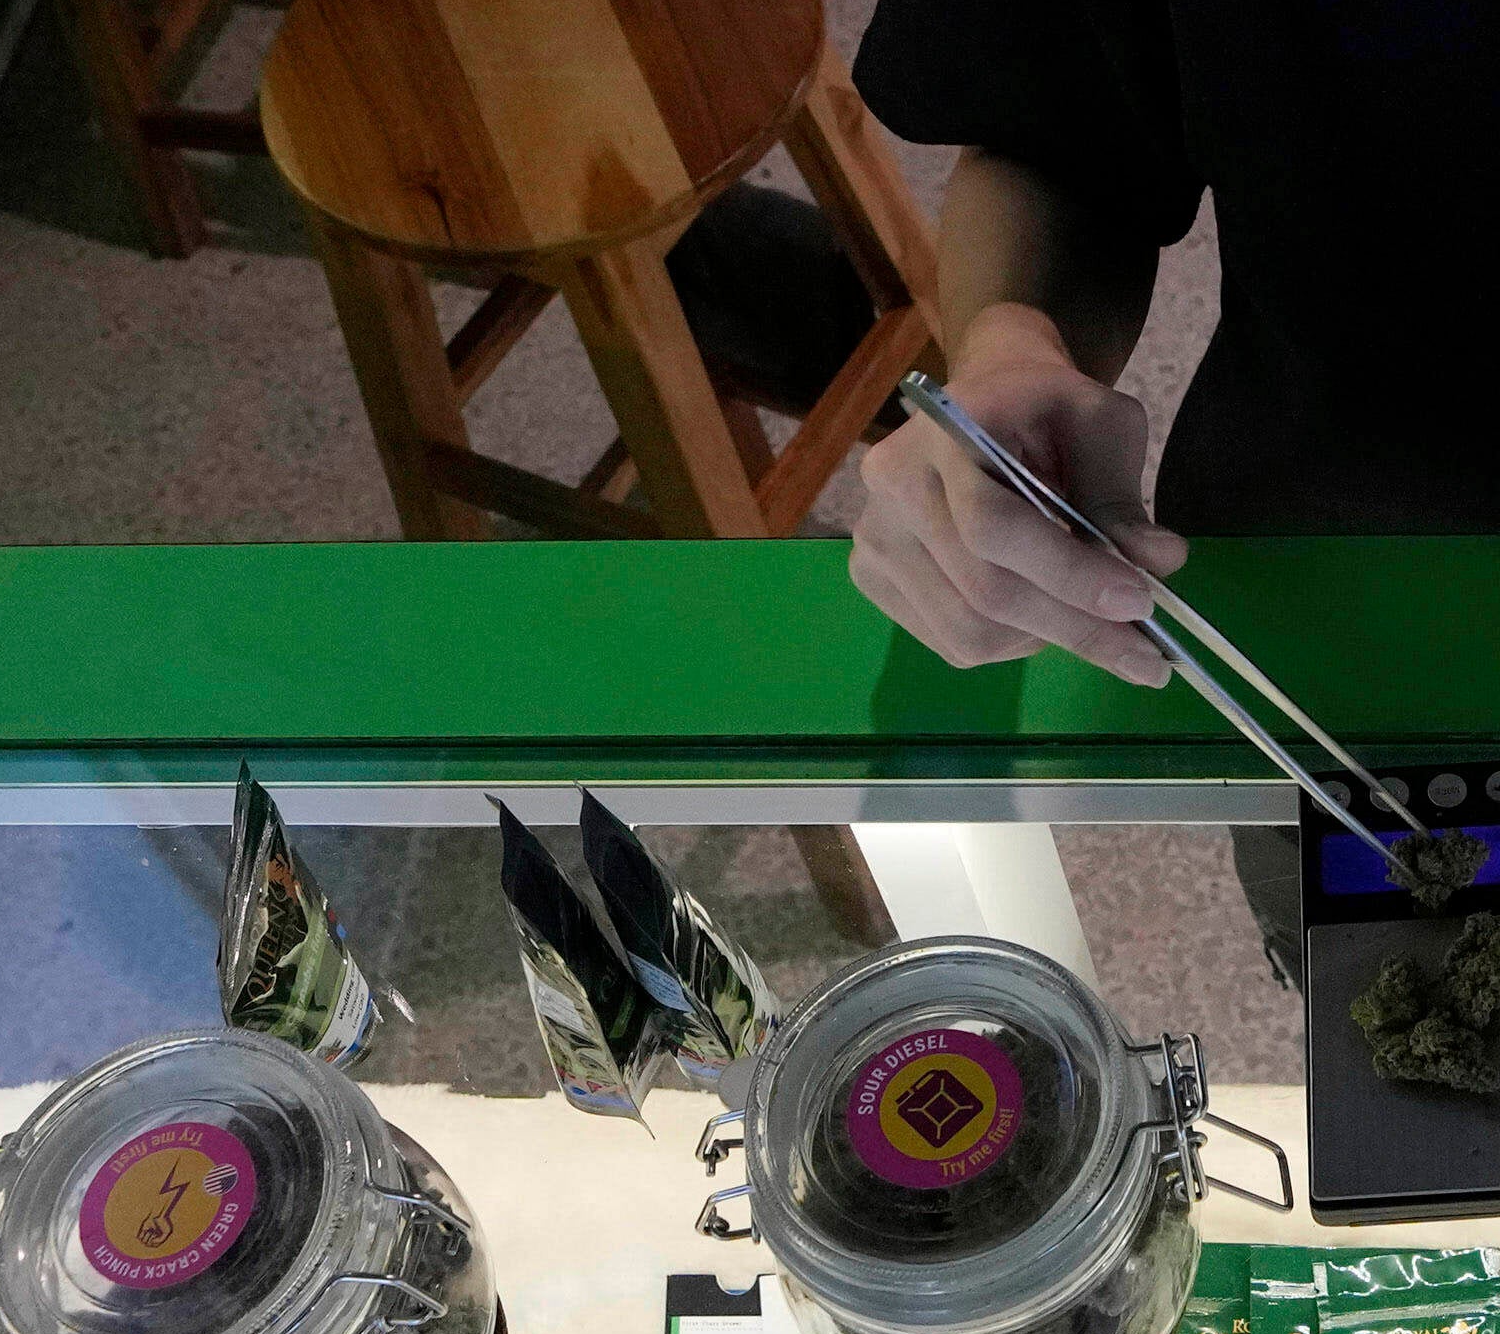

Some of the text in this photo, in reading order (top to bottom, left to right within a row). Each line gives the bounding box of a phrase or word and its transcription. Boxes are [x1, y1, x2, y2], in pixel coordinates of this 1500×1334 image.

[858, 1035, 948, 1116] SOUR DIESEL
[940, 1159, 966, 1176] Try
[968, 1143, 993, 1166] me
[94, 1203, 239, 1279] GREEN CRACK PUNCH
